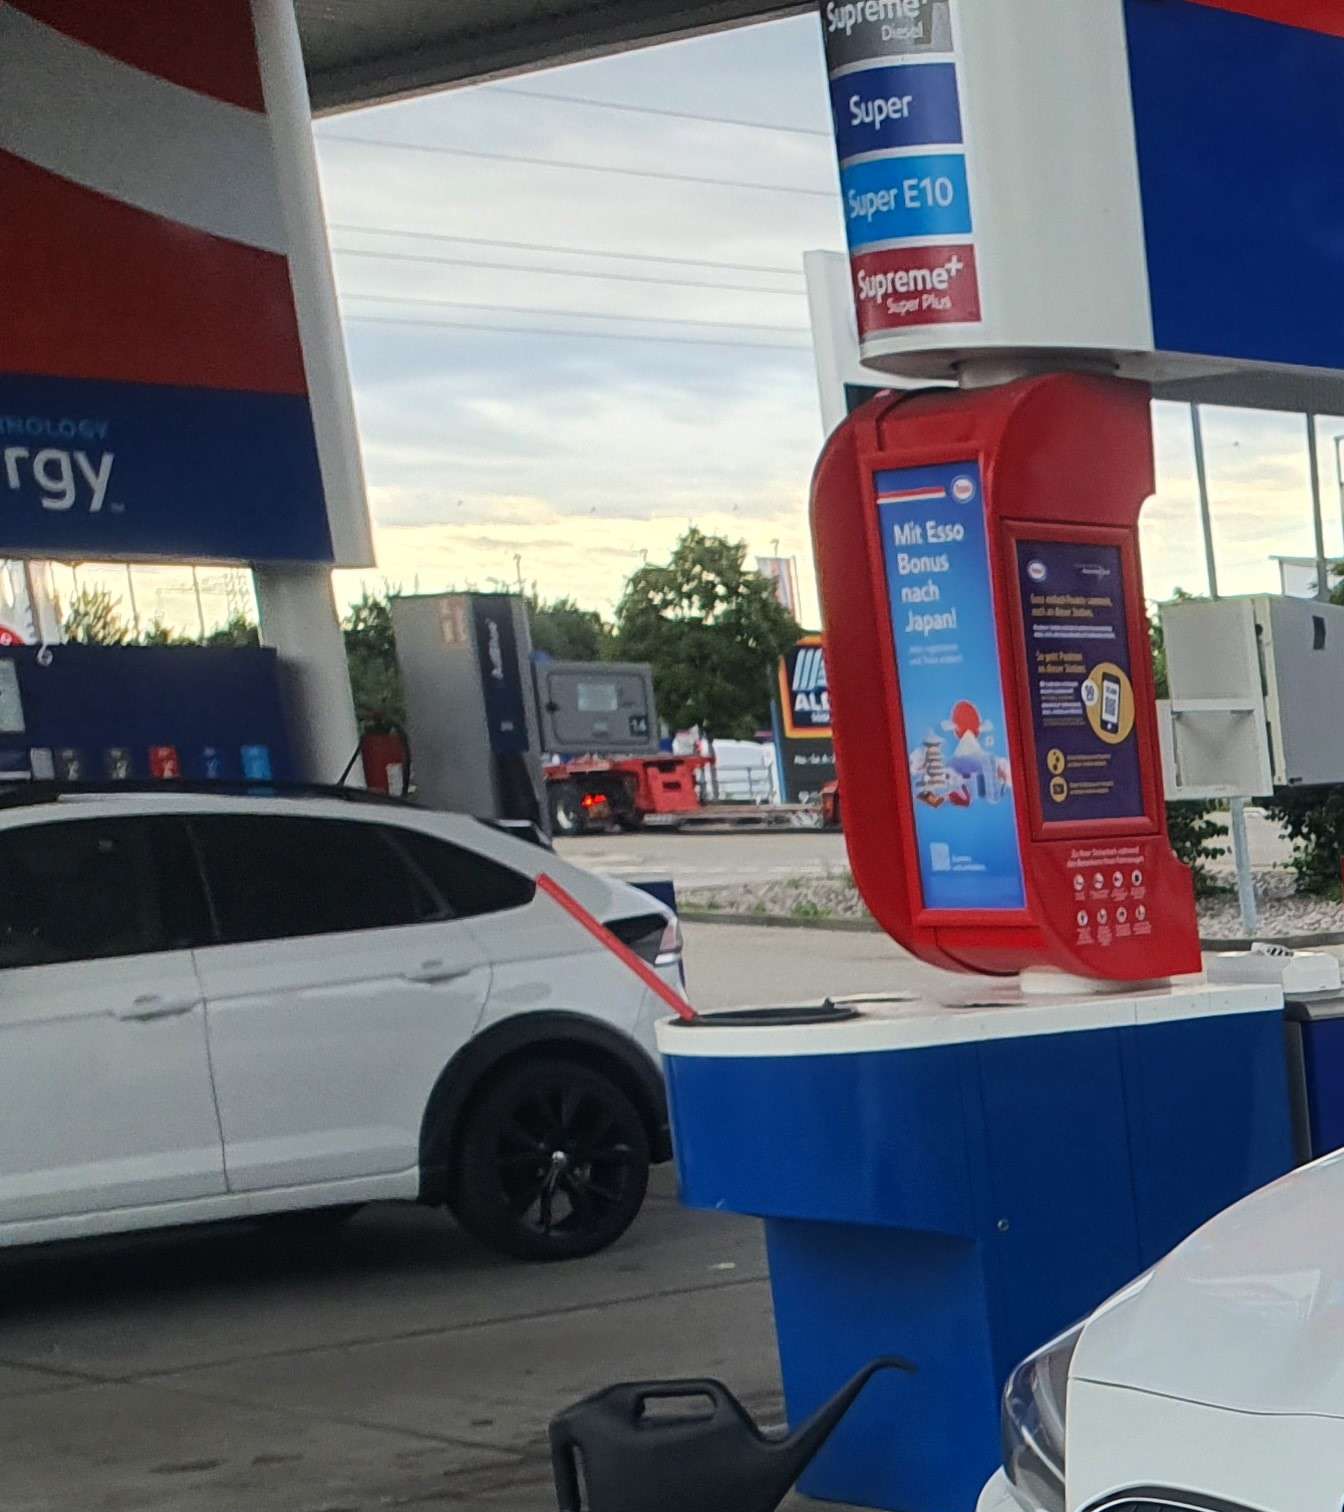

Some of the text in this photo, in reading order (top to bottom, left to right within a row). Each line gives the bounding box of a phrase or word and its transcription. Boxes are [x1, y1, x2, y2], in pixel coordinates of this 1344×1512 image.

[826, 0, 928, 36] Supreme
[850, 94, 913, 131] Super
[848, 176, 954, 222] Super E10
[893, 519, 965, 546] Mit Esso
[897, 552, 949, 576] Bonus
[902, 579, 940, 603] nach
[905, 607, 957, 637] Japan!
